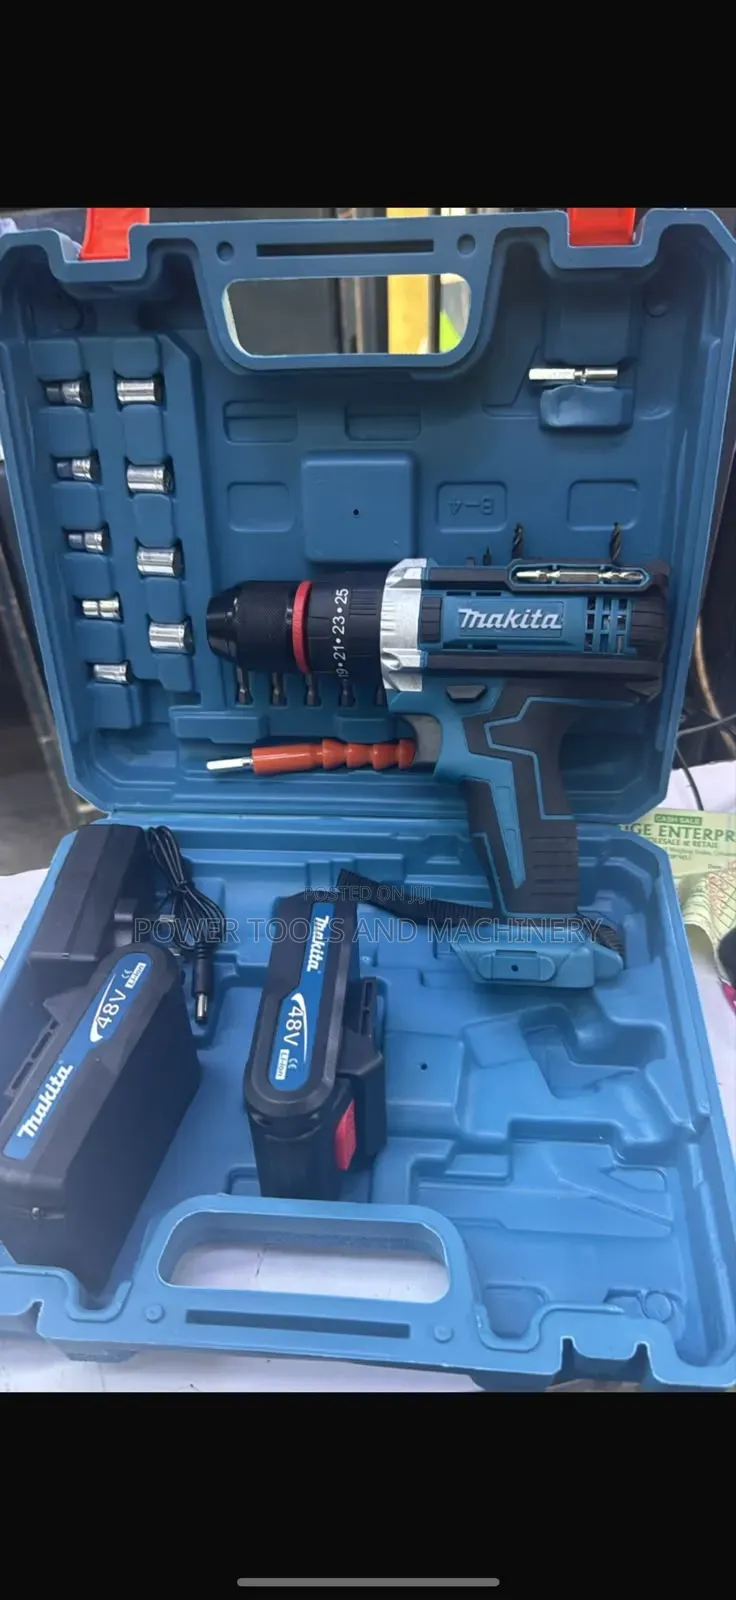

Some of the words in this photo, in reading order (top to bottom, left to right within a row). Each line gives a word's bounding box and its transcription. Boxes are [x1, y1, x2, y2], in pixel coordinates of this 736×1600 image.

[334, 588, 349, 605] 25
[332, 616, 345, 635] 23
[332, 645, 346, 660] 21
[659, 825, 736, 843] ENTERPR
[96, 988, 127, 1030] 48V
[283, 1005, 304, 1047] 48V
